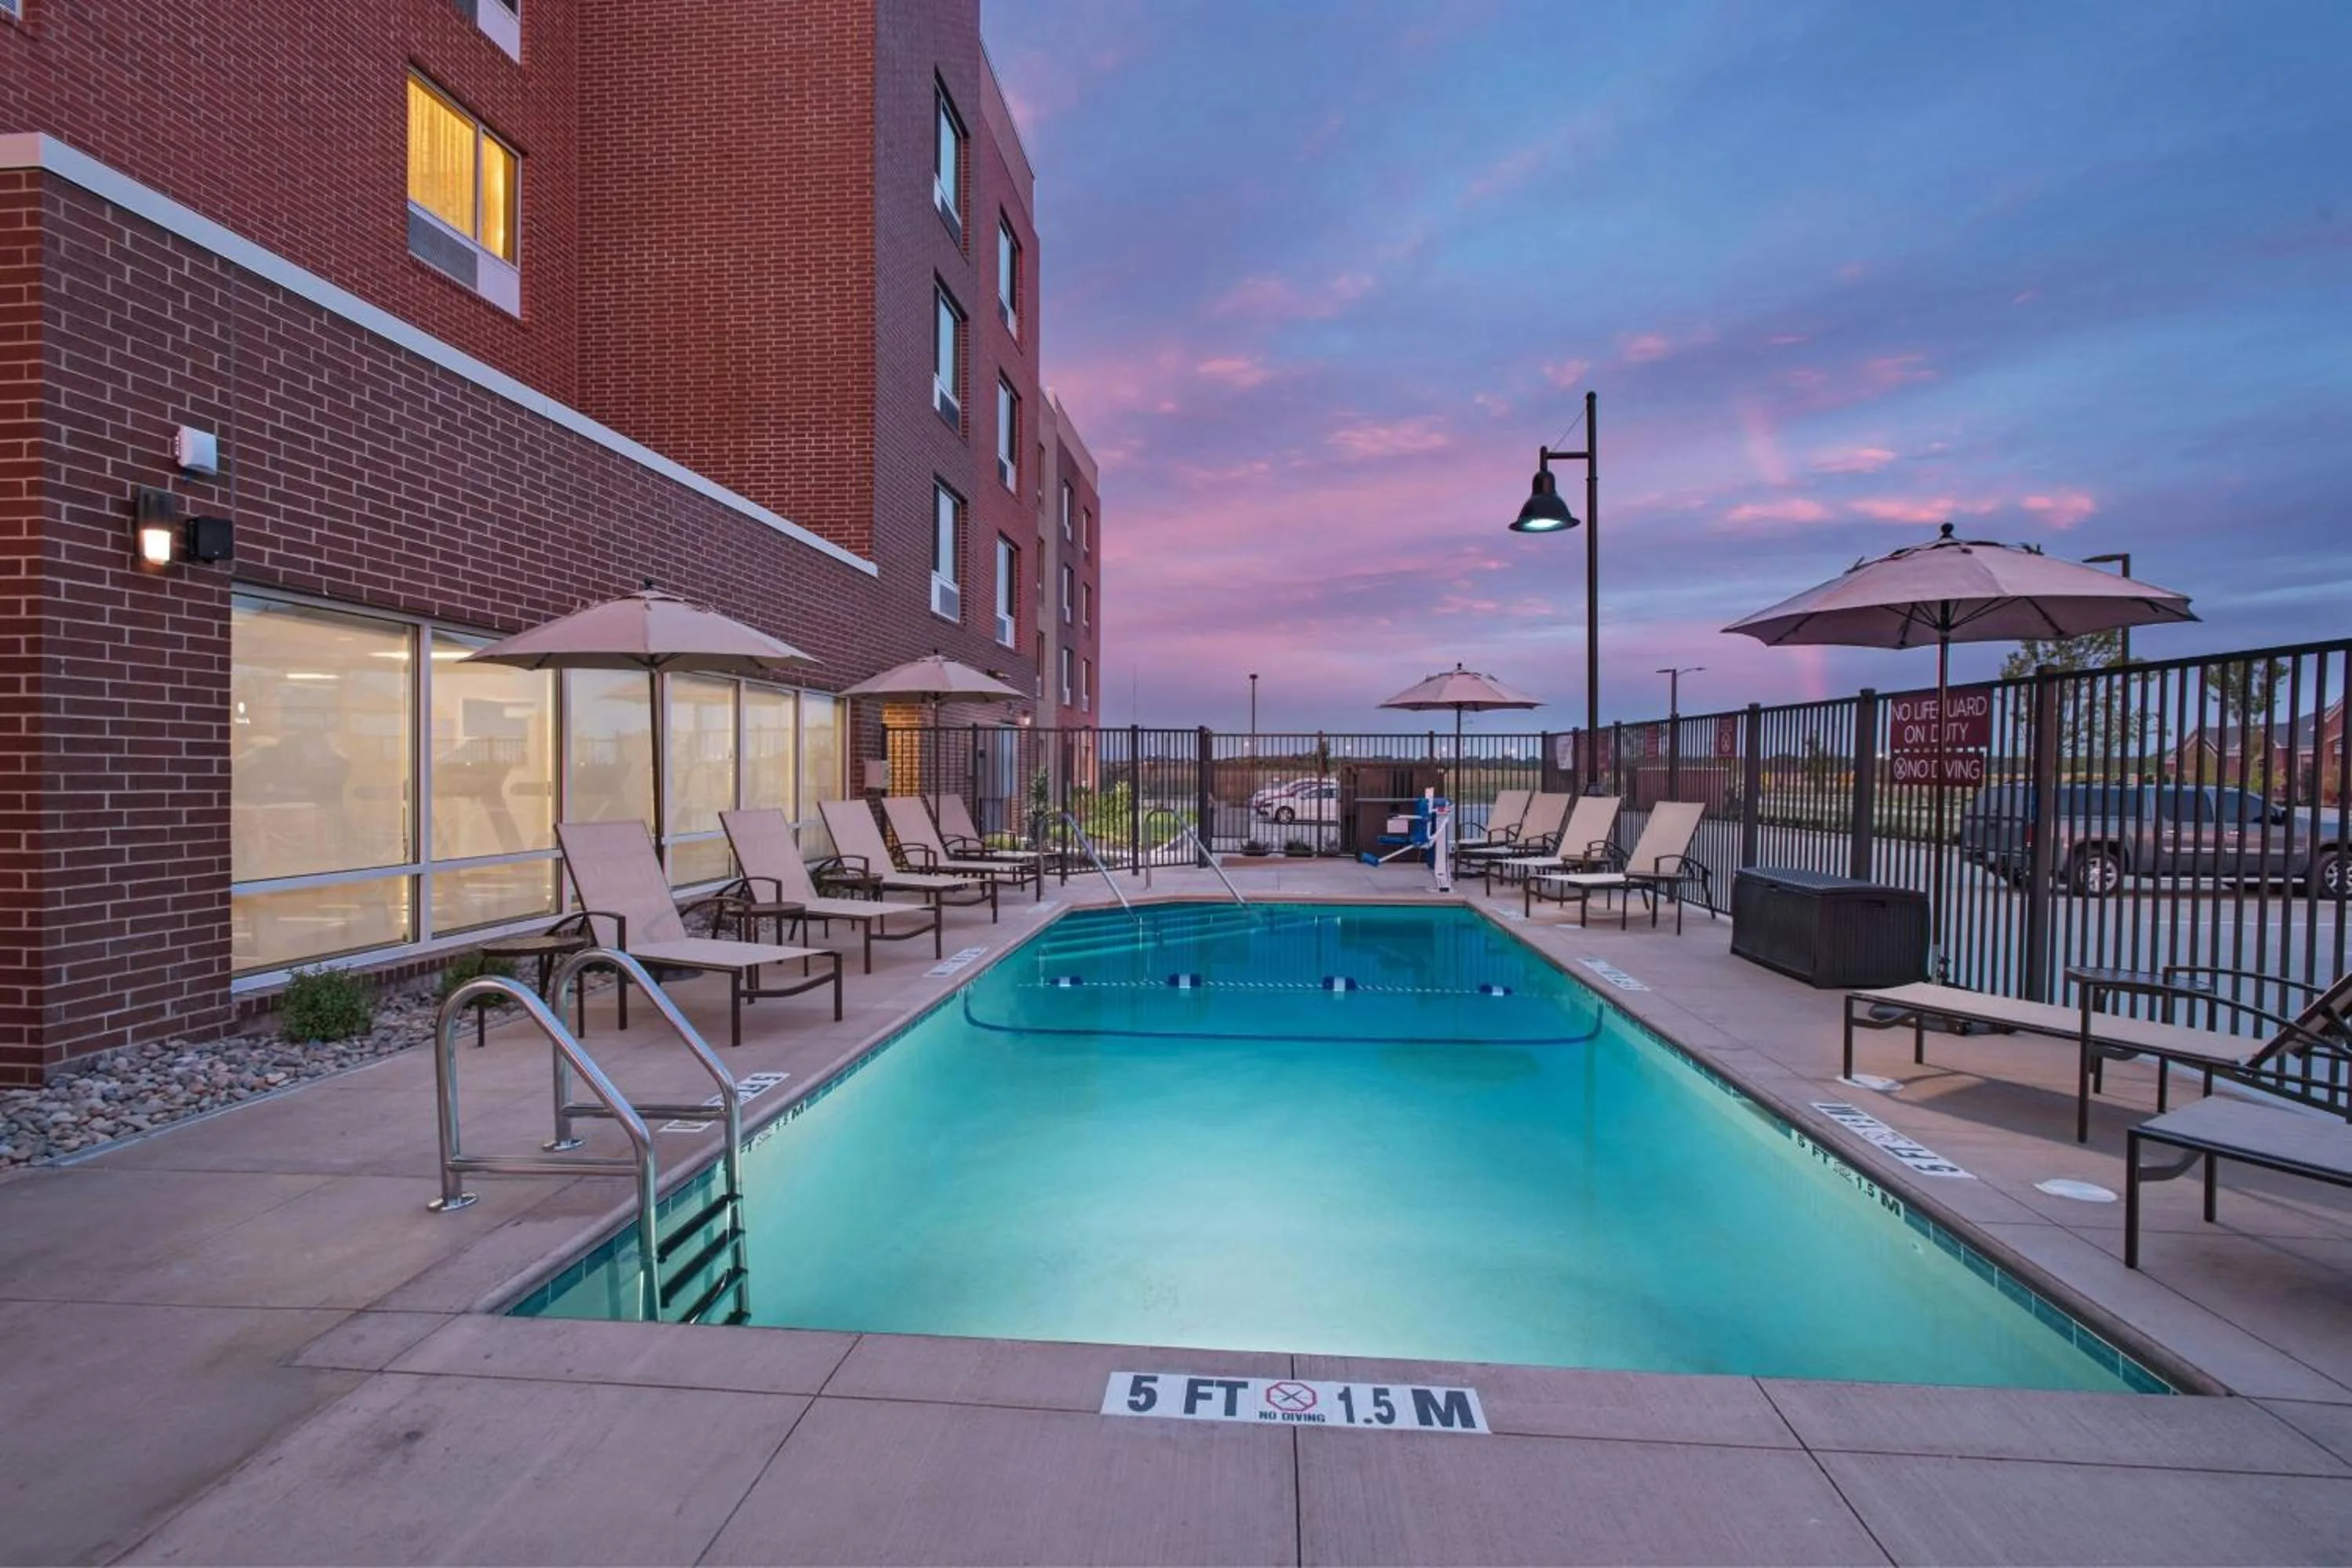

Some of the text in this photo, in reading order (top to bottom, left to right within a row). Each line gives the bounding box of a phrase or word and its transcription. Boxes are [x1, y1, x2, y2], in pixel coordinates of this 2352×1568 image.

[1893, 696, 1987, 721] NO LIFEUARD
[1904, 724, 1926, 744] ON
[1907, 759, 1980, 779] NO DVING
[1797, 1134, 1901, 1217] 5 FT 1.5 M
[1127, 1374, 1477, 1428] 5 FT 1.5 M
[1259, 1410, 1326, 1423] NO DIVING
